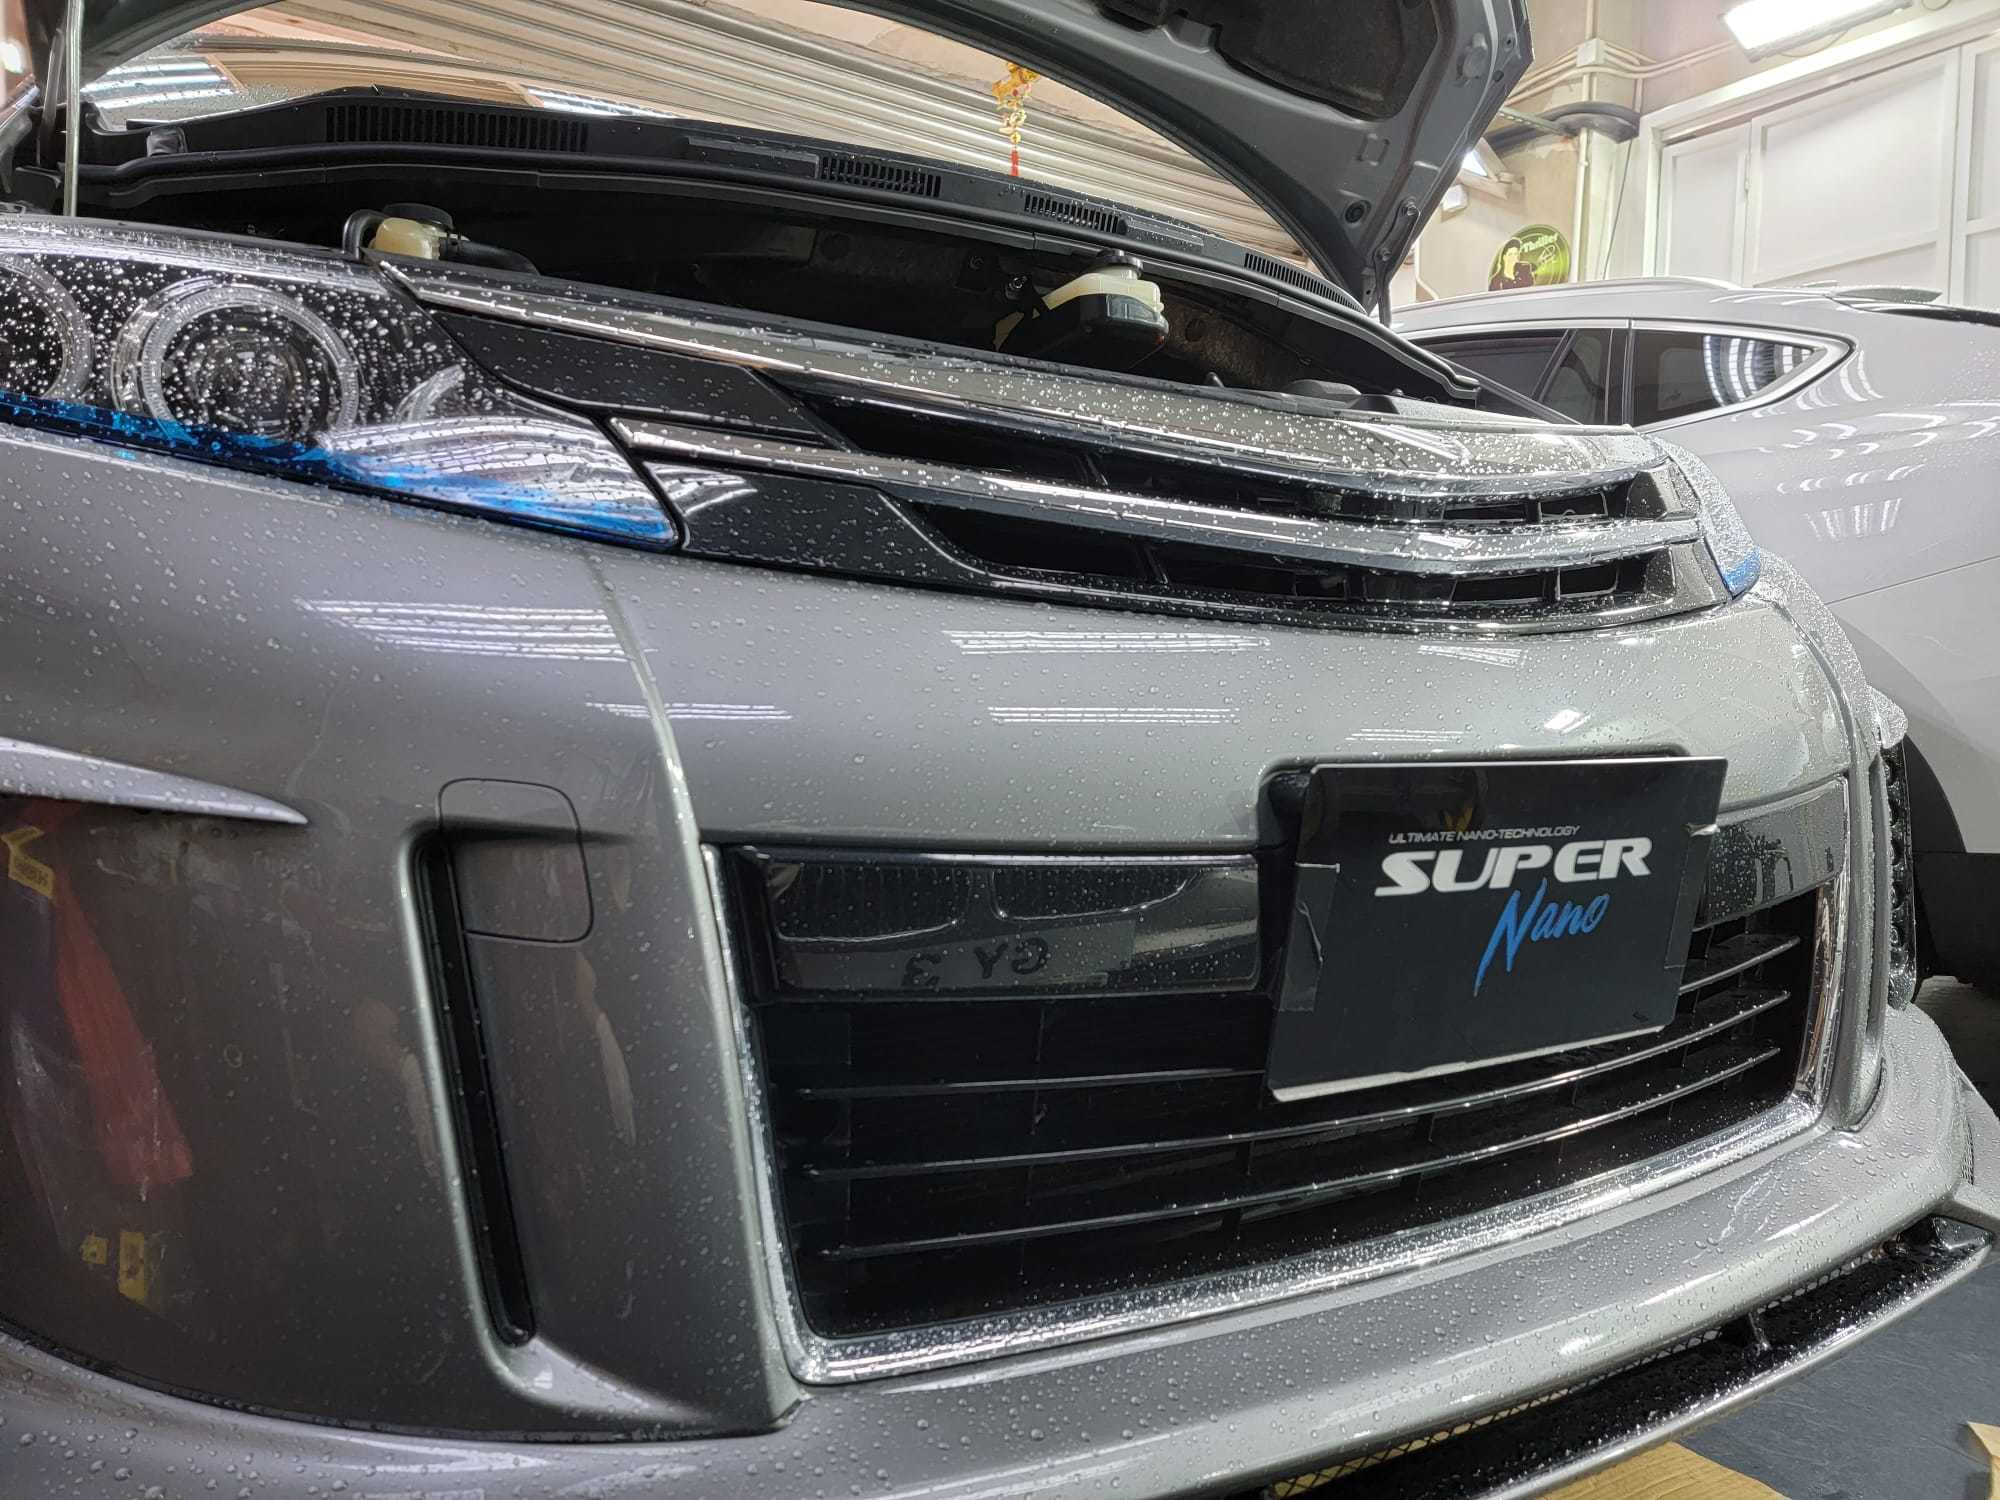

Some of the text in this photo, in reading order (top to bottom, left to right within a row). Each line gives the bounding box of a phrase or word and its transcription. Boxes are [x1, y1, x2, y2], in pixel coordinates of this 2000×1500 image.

[1389, 825, 1581, 844] ULTIMATE NANO-TECHNOLOGY
[1374, 837, 1653, 897] SUPER
[1472, 877, 1611, 998] Nano
